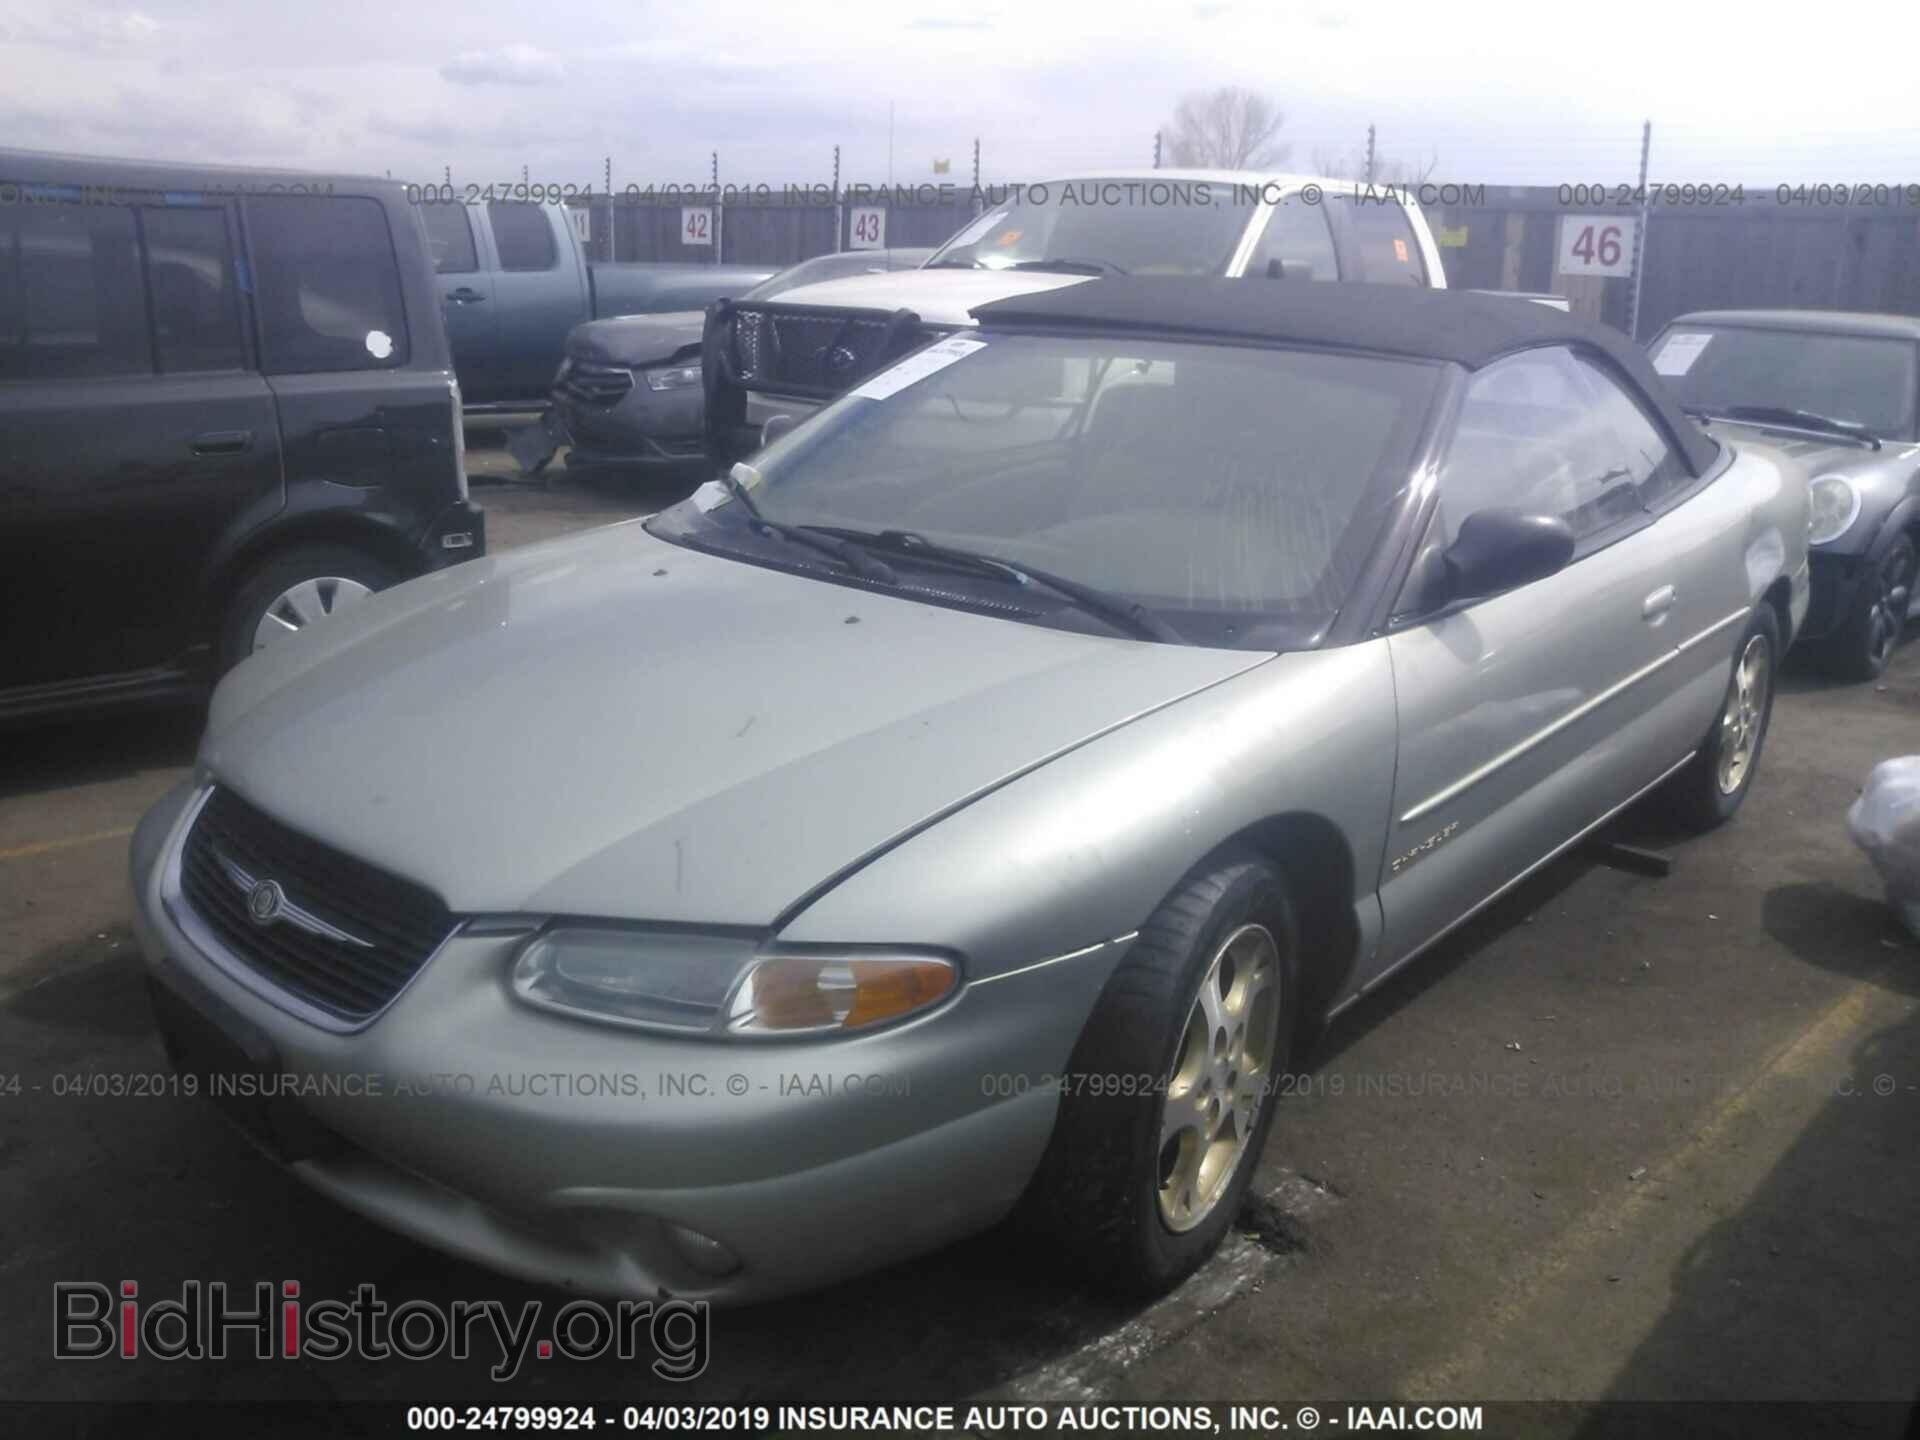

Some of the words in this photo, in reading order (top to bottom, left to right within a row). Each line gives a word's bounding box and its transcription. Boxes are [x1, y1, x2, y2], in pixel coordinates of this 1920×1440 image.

[687, 213, 707, 238] 42
[856, 213, 880, 243] 43
[1571, 225, 1622, 266] 46
